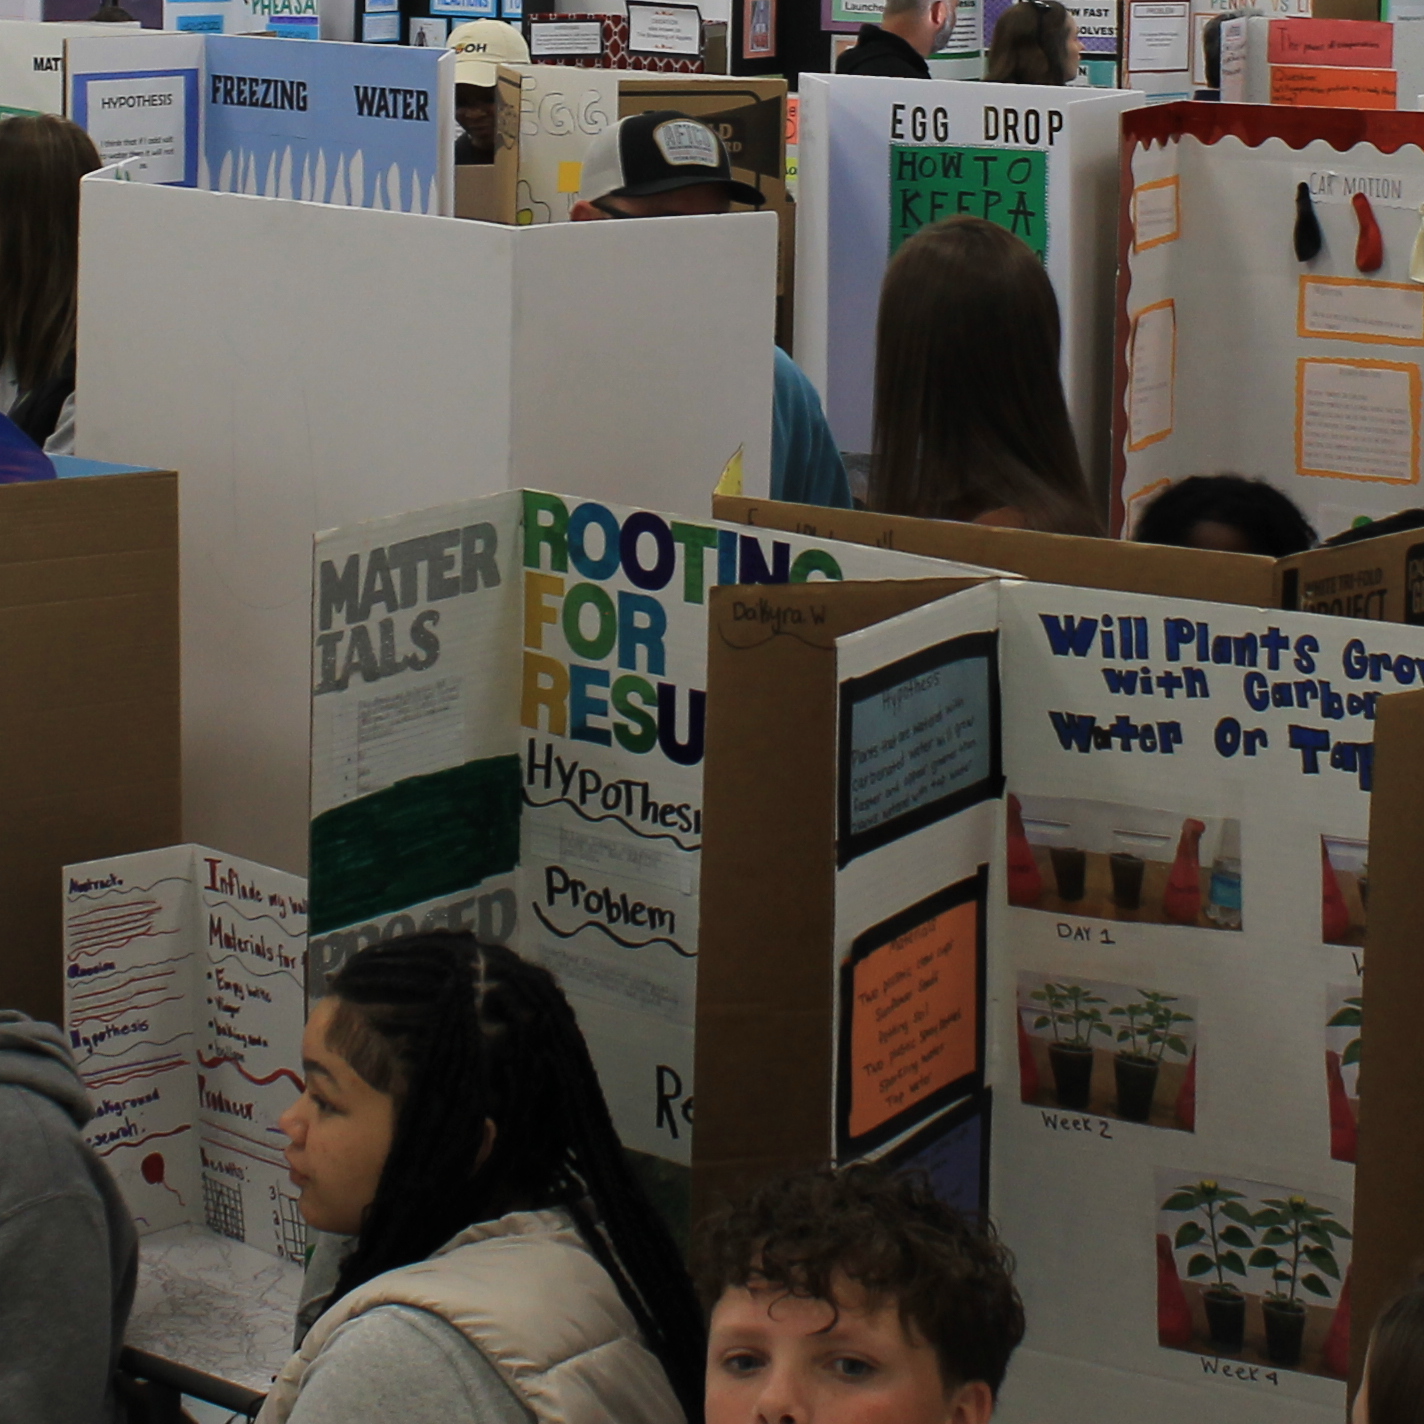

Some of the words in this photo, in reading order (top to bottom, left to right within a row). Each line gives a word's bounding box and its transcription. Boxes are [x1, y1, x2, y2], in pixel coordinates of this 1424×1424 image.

[1083, 7, 1109, 18] FAST
[101, 93, 173, 110] HYPOTHESIS
[210, 74, 307, 112] FREEZING
[354, 84, 429, 122] WATER
[891, 103, 949, 142] EGG
[983, 106, 1064, 146] DROP
[973, 154, 1033, 187] TO
[1309, 172, 1334, 198] CAR
[1007, 190, 1035, 237] A
[319, 520, 502, 632] MATER
[523, 570, 666, 677] FOR
[1040, 612, 1148, 661] Will
[1163, 617, 1319, 675] Plants
[1048, 710, 1184, 756] Water
[1214, 717, 1269, 758] Or
[544, 865, 676, 935] Problem
[1042, 1111, 1094, 1134] Week
[1098, 1120, 1114, 1139] 2
[1200, 1356, 1259, 1382] Week
[1264, 1370, 1280, 1386] 4
